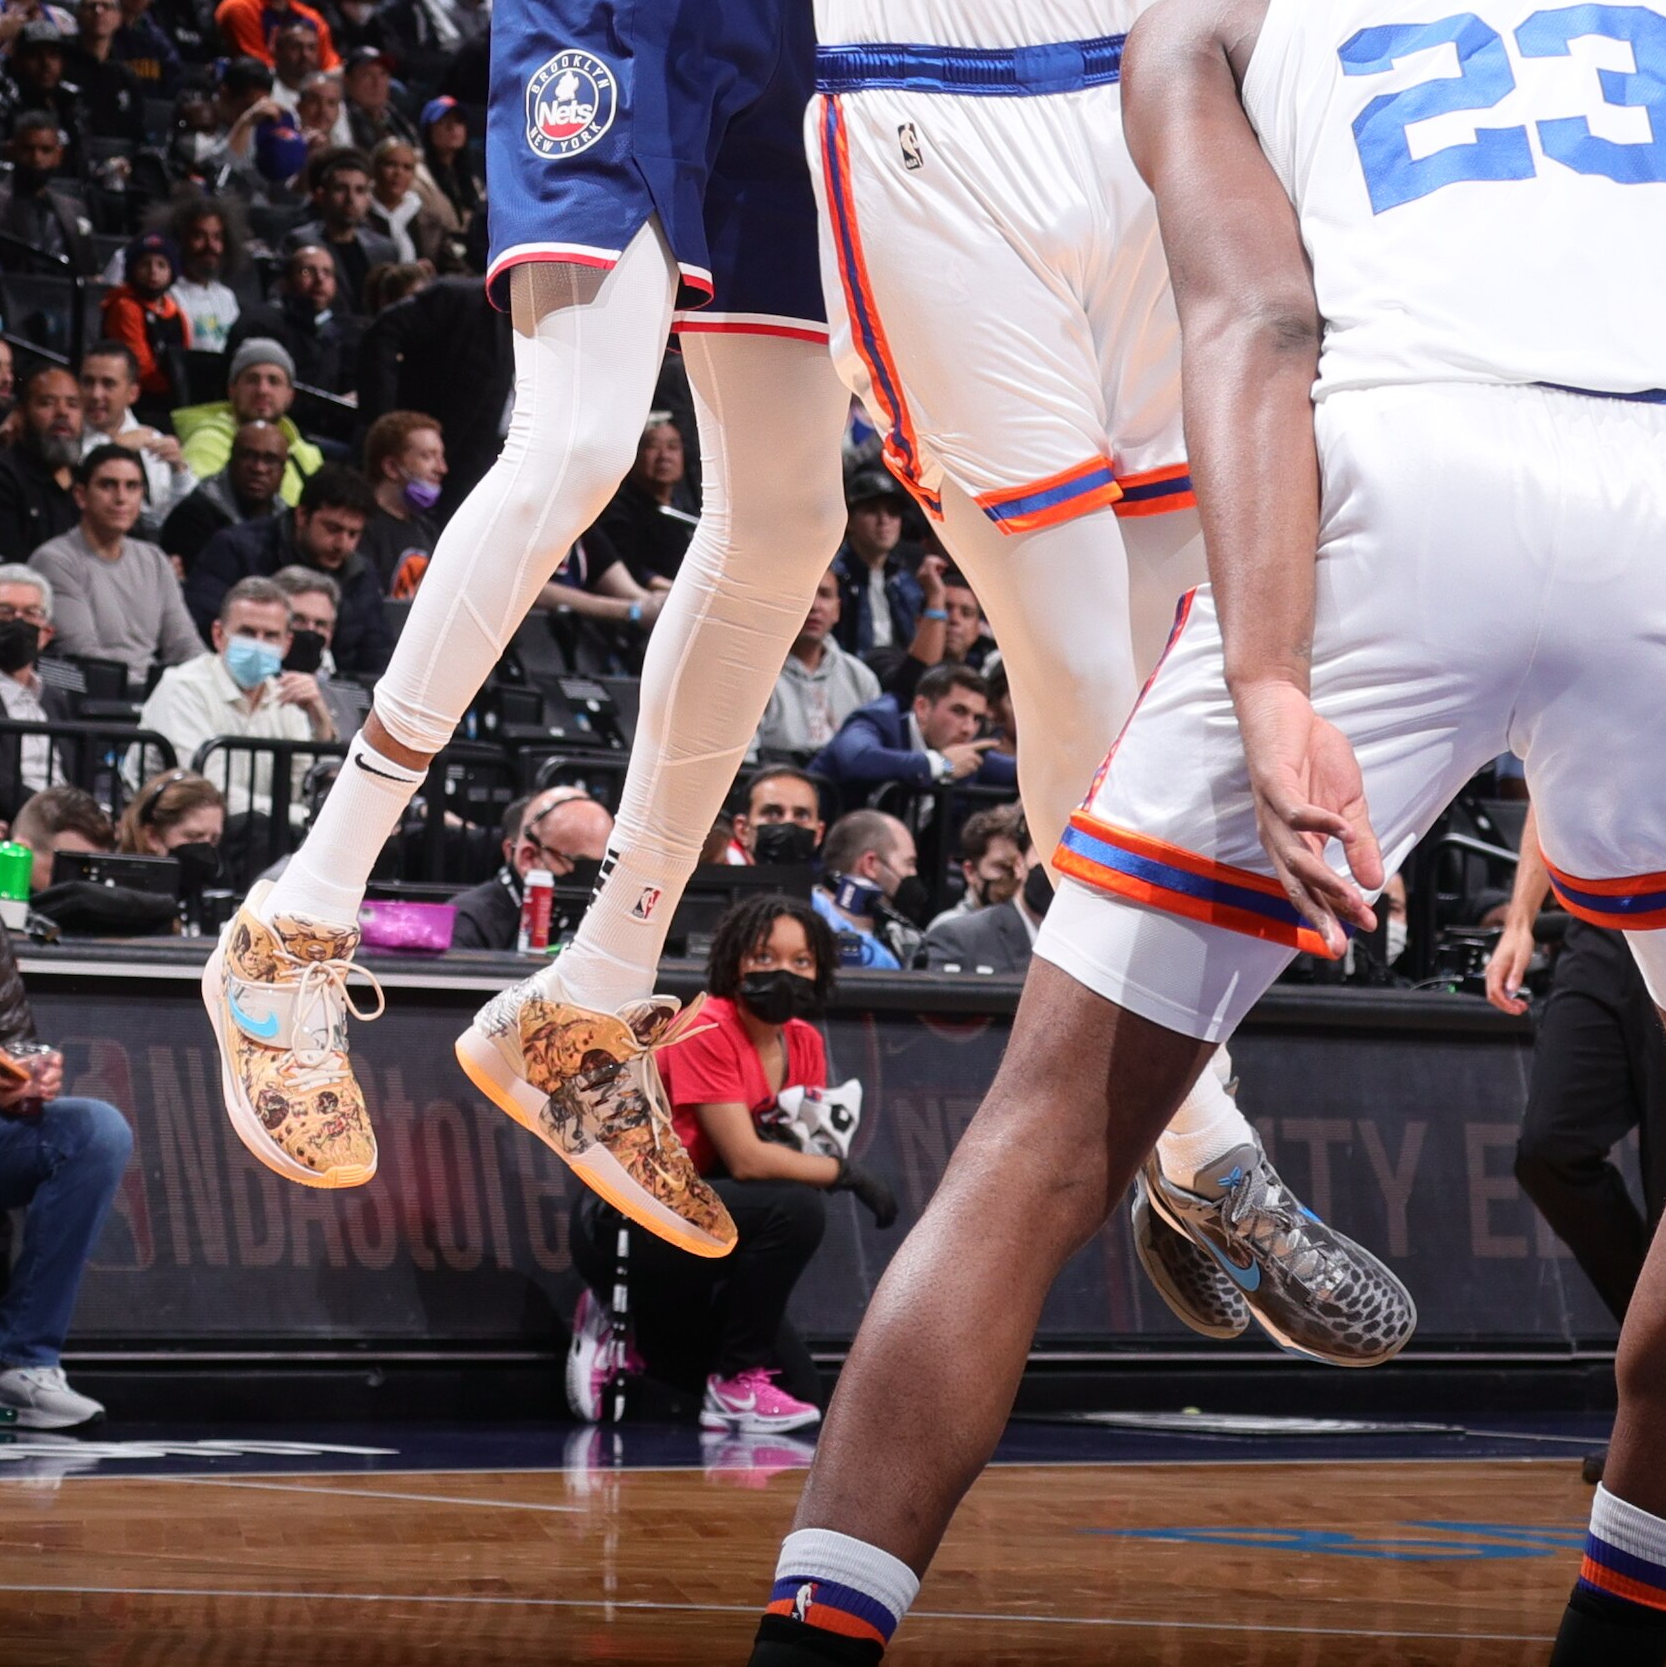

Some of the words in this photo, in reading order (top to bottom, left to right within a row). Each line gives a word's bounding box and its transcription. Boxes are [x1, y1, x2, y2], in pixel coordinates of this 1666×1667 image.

[530, 54, 611, 94] BROOKLYN
[538, 99, 594, 128] Nets
[529, 125, 554, 153] NEW
[560, 121, 602, 153] YORK
